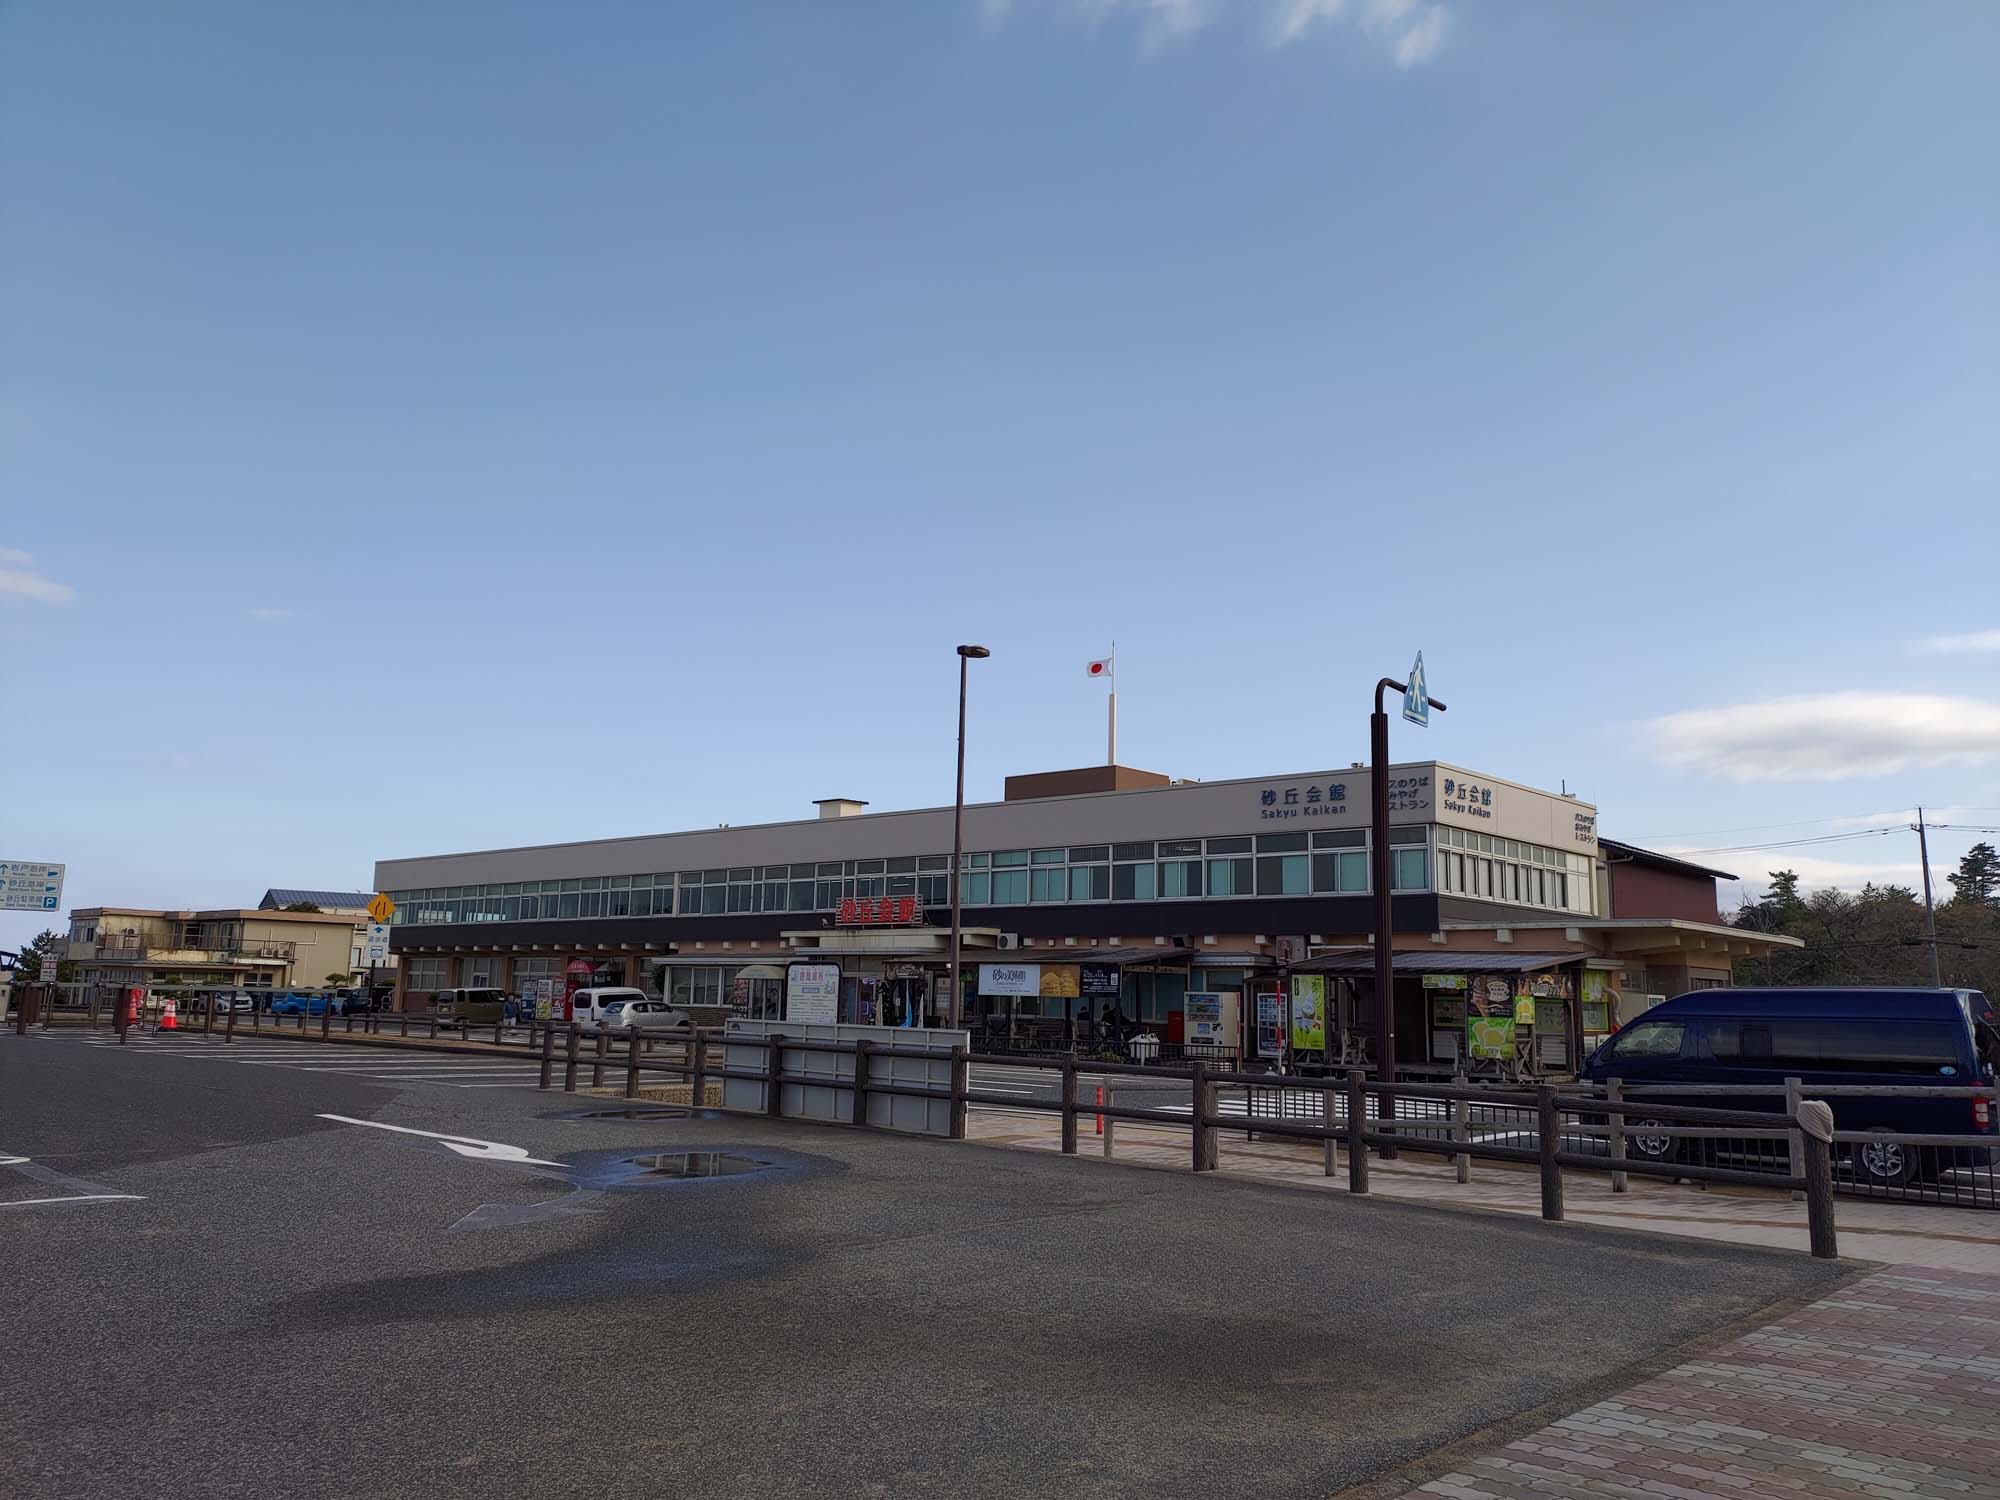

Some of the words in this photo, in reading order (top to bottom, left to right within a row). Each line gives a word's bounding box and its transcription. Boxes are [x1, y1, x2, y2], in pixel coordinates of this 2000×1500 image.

[1261, 783, 1346, 806] 砂丘会館
[1444, 778, 1491, 806] 砂丘会館
[1261, 808, 1297, 819] Sakyu
[1304, 804, 1346, 817] Kaikan
[1444, 800, 1466, 814] Sakyu
[1468, 804, 1491, 818] Kaikan
[841, 896, 916, 923] 砂丘会館
